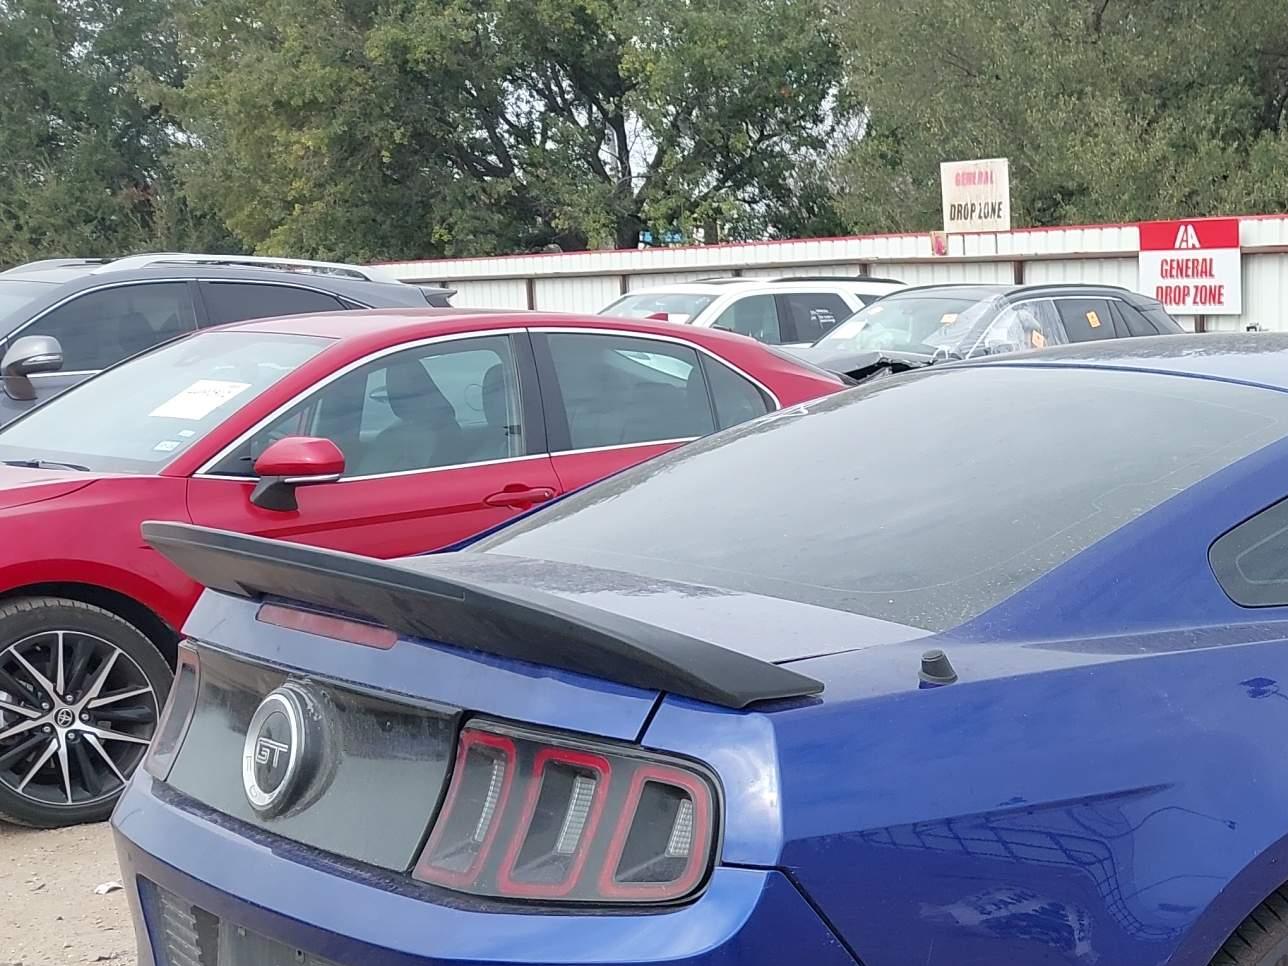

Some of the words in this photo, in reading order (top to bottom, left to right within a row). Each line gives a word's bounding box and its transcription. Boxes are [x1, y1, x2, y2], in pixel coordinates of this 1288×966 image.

[955, 170, 994, 186] GENERAL
[949, 203, 976, 221] DROP
[978, 201, 1003, 220] ZONE
[1160, 258, 1215, 279] GENERAL
[1156, 285, 1190, 306] DROP
[1192, 284, 1225, 305] ZONE
[255, 736, 289, 769] GT
